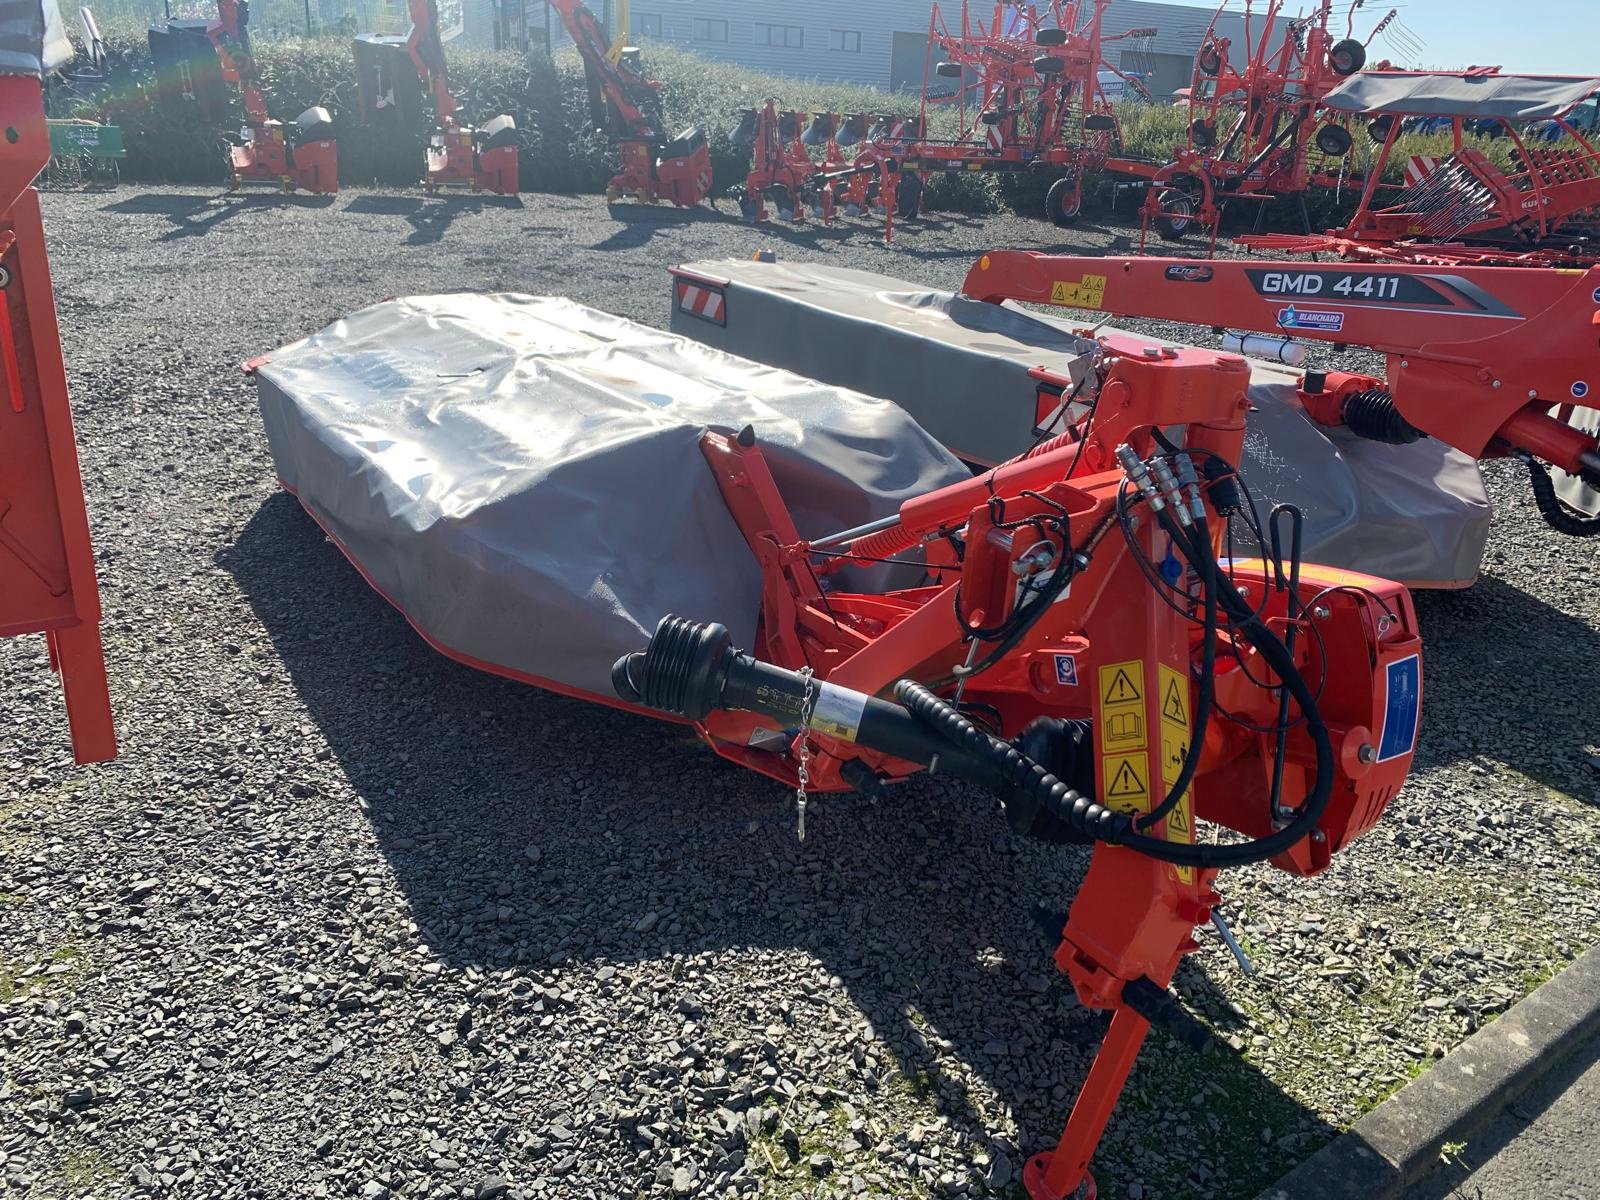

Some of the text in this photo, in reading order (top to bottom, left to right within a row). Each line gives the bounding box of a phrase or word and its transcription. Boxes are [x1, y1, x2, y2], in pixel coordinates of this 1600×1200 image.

[1262, 273, 1400, 298] GMD 4411
[1299, 312, 1341, 323] BLANCHARD
